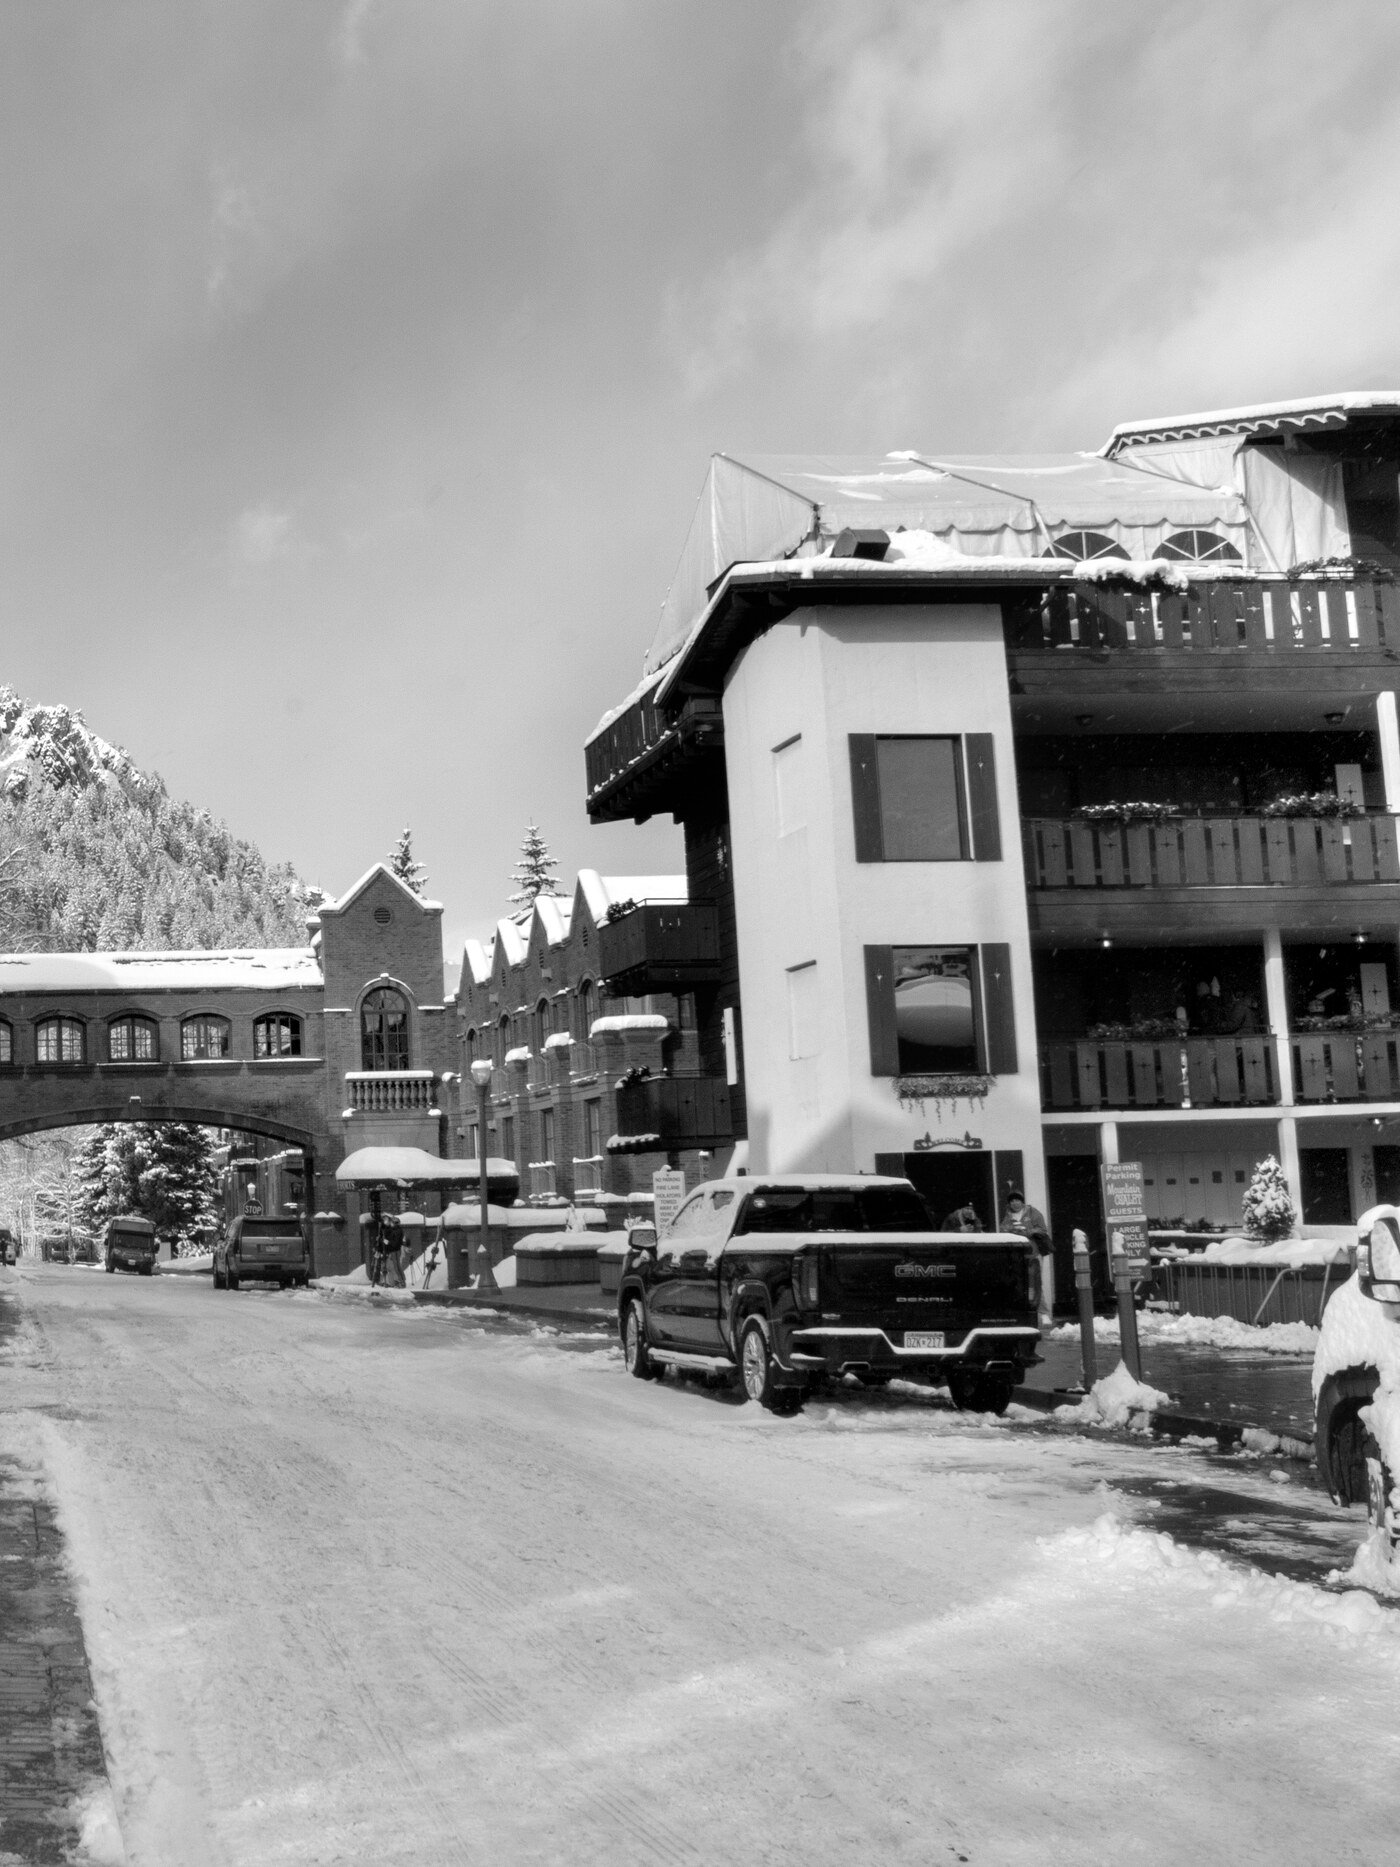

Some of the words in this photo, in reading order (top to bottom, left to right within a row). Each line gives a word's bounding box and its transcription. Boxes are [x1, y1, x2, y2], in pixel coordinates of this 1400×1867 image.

[1107, 1163, 1138, 1172] Permit
[1105, 1172, 1141, 1180] Parking
[244, 1205, 262, 1214] STOP
[1110, 1207, 1143, 1215] GUESTS
[894, 1264, 957, 1278] GMC
